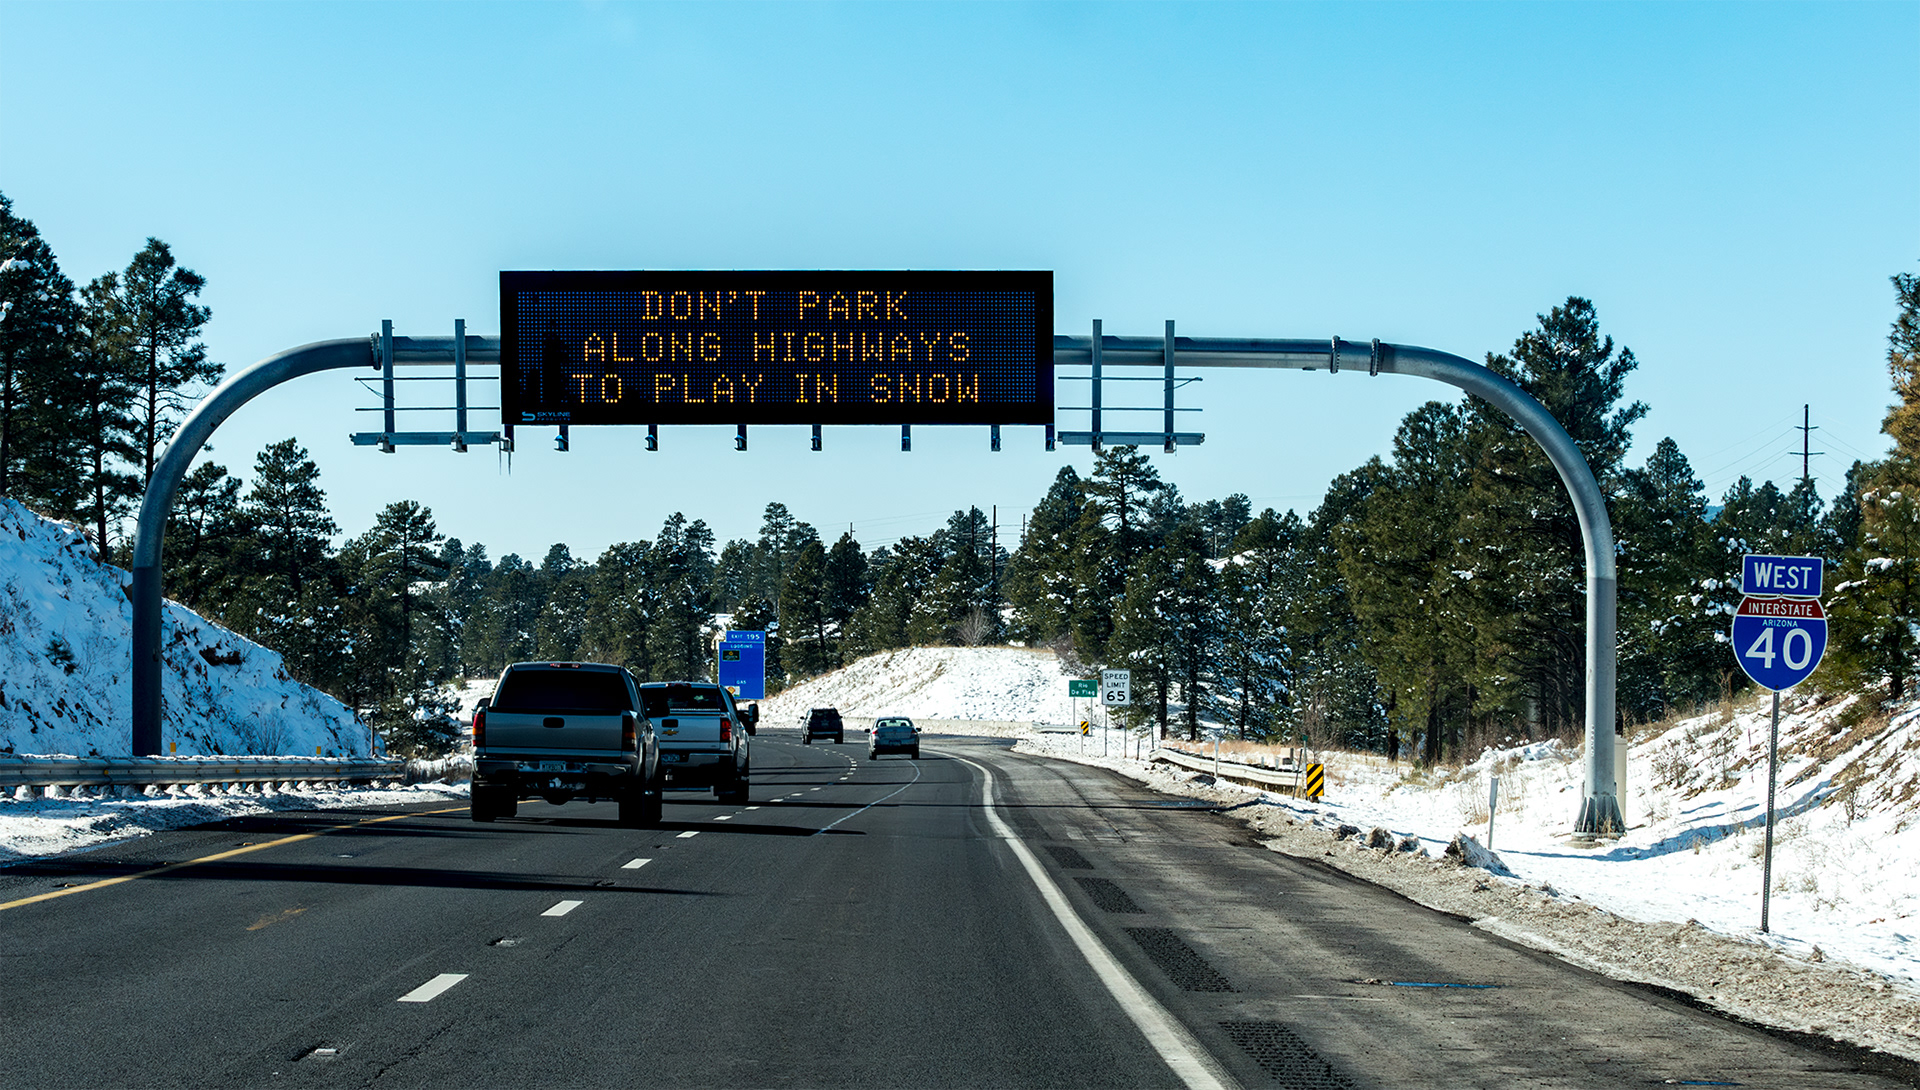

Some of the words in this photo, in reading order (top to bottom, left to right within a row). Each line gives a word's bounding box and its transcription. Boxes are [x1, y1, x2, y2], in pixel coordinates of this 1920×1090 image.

[641, 290, 766, 320] DON'T
[800, 290, 908, 320] PARK
[585, 332, 721, 361] ALONG
[754, 332, 969, 361] HIGHWAYS
[572, 373, 622, 403] TO
[655, 373, 763, 403] PLAY
[796, 373, 838, 403] IN
[871, 373, 979, 403] SNOW
[1754, 562, 1813, 590] WEST
[1748, 602, 1813, 616] INTERSTATE
[1762, 619, 1799, 628] ARIZONA
[1745, 627, 1813, 671] 40
[1106, 690, 1126, 702] 65
